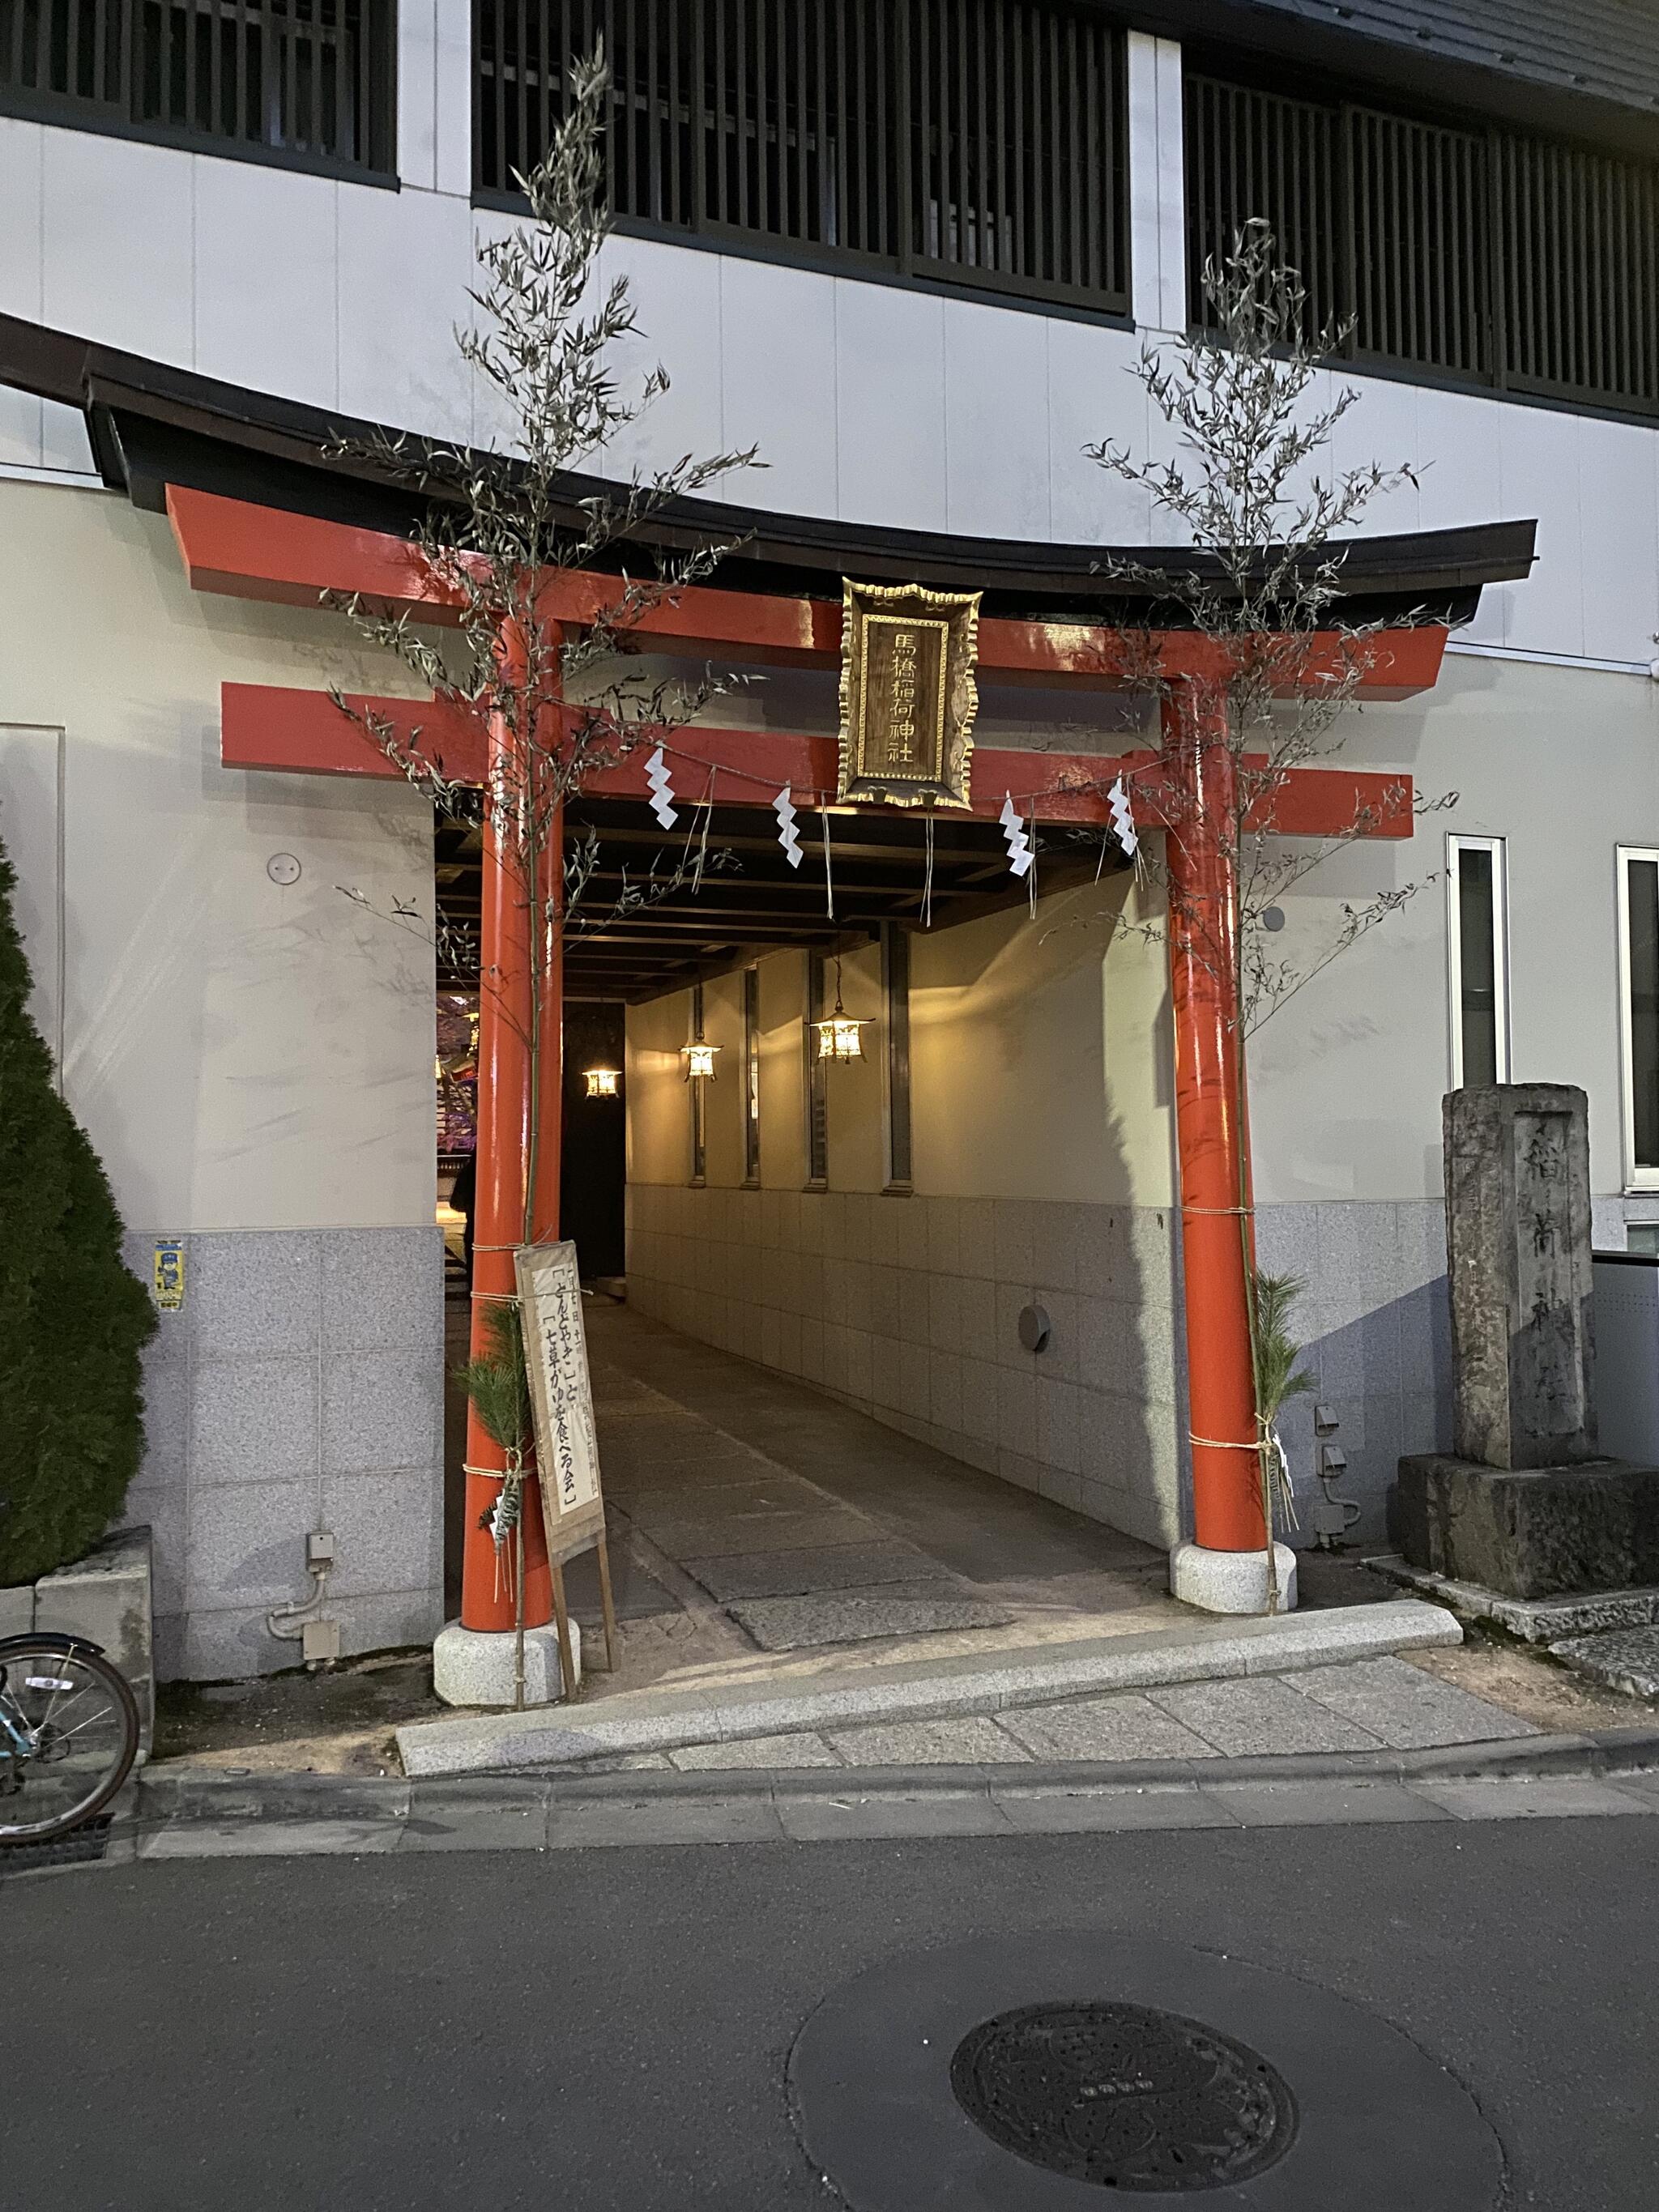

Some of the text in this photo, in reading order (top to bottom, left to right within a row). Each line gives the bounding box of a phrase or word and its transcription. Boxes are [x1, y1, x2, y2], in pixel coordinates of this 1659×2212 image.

[888, 633, 917, 763] 馬橋稲荷神社
